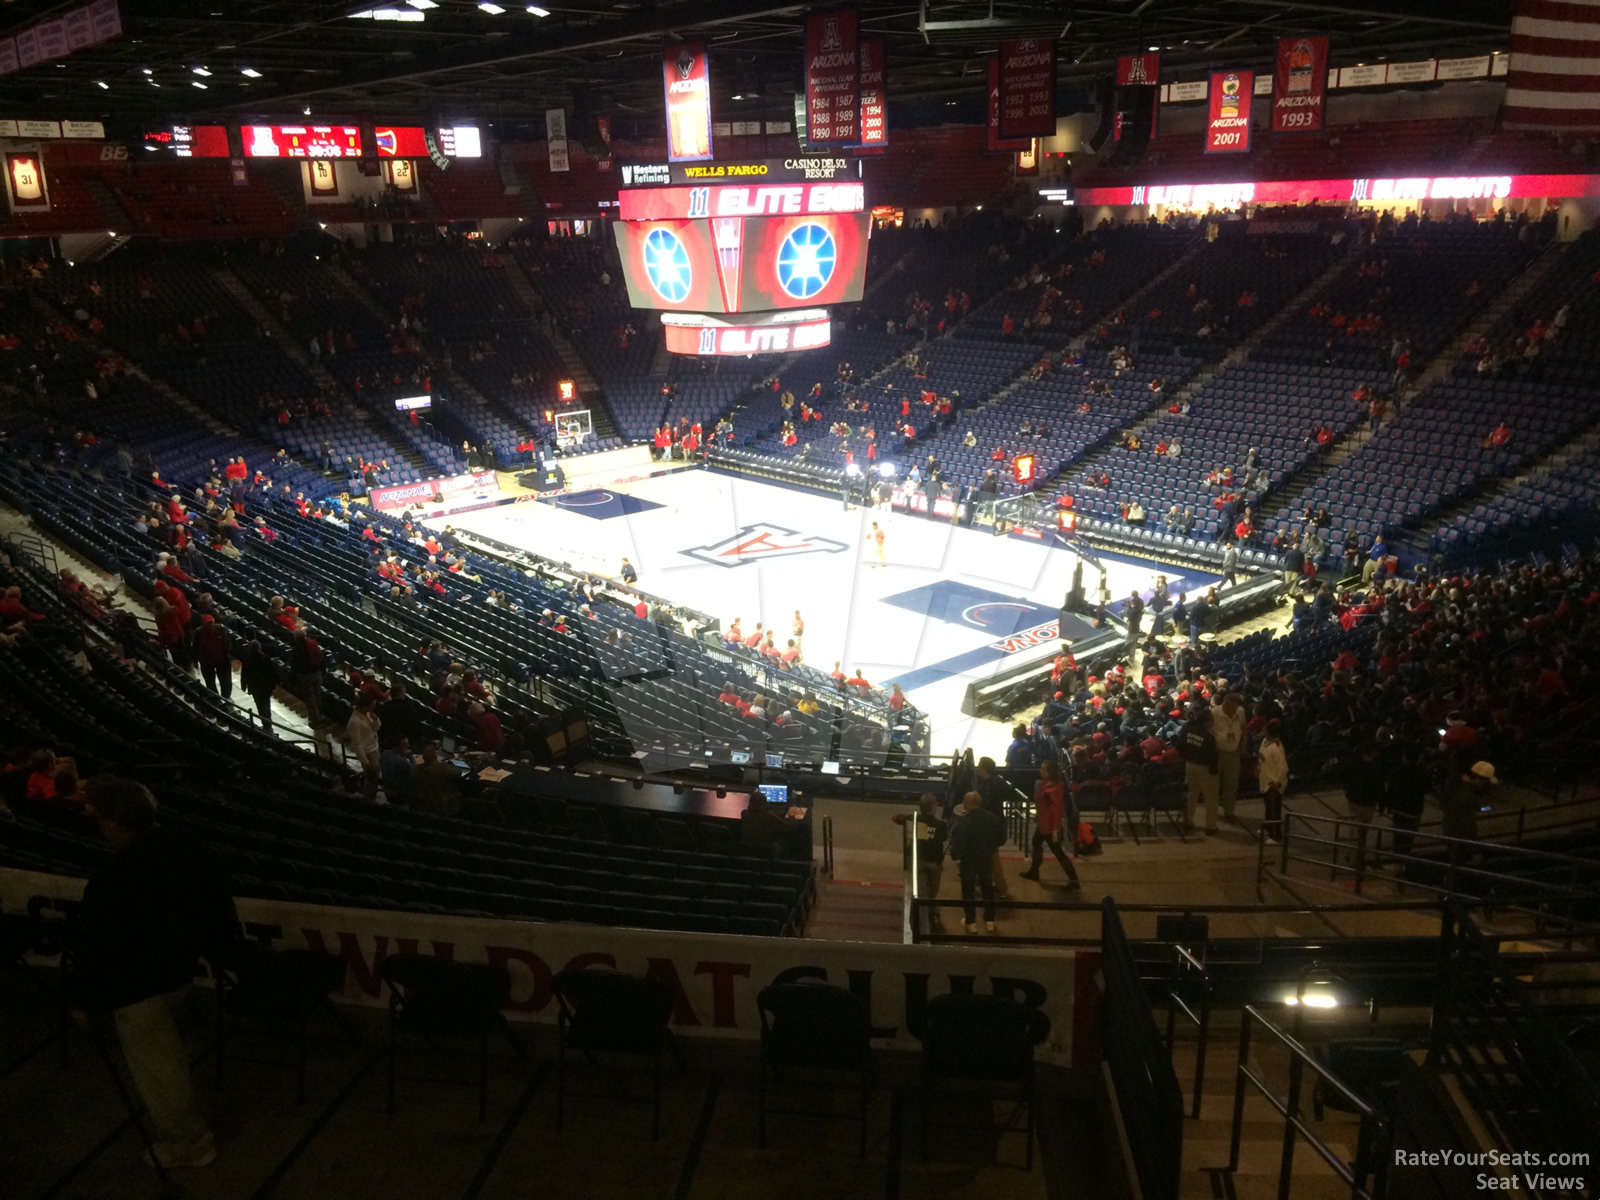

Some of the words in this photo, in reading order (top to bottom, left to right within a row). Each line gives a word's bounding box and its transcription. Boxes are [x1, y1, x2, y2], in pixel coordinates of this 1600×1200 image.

[811, 52, 854, 69] ARIZONA
[1005, 52, 1050, 69] ARIZONA
[812, 97, 830, 109] 1984
[835, 95, 854, 107] 1987
[1005, 94, 1024, 106] 1992
[1029, 90, 1049, 102] 1993
[1276, 95, 1321, 108] ARIZONA
[835, 110, 854, 122] 1989
[866, 105, 881, 116] 1994
[1006, 107, 1025, 119] 1996
[1029, 105, 1048, 116] 2002
[1211, 118, 1248, 128] ARIZONA
[1281, 112, 1313, 127] 1993
[812, 127, 830, 139] 1990
[835, 125, 853, 137] 1991
[1213, 133, 1241, 145] 2001
[100, 146, 129, 161] BE
[633, 165, 670, 175] Western
[684, 166, 725, 178] WELLS
[727, 164, 768, 177] FARGO
[784, 159, 820, 169] CASINO
[820, 159, 836, 169] DEL
[836, 159, 847, 169] SOL
[397, 168, 407, 177] 22
[634, 174, 671, 184] Refining
[805, 168, 835, 179] RESORT
[21, 175, 32, 185] 31
[1372, 179, 1429, 200] ELITE
[688, 187, 710, 218] 11
[717, 187, 804, 216] ELITE
[698, 328, 716, 354] 11
[720, 328, 789, 352] ELITE
[379, 486, 424, 503] ARIZONA
